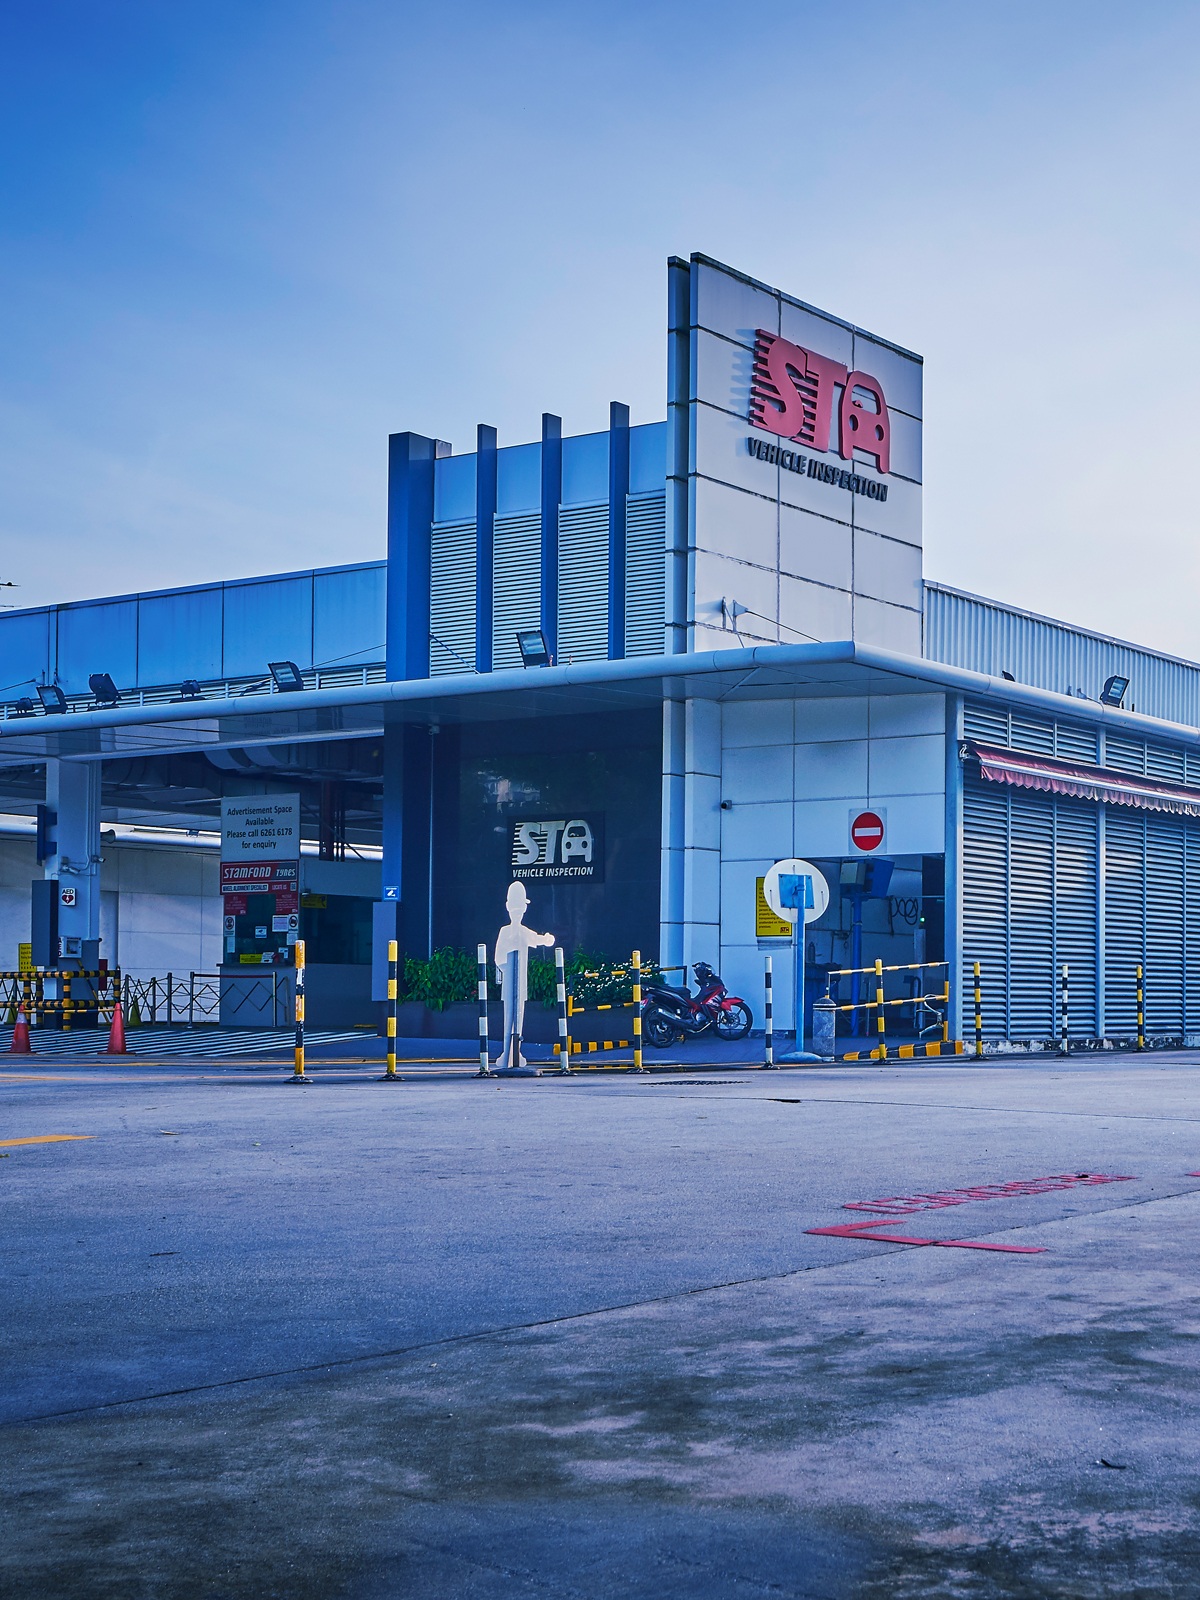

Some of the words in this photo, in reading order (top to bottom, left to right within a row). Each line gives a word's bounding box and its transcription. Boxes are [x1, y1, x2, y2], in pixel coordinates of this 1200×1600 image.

[748, 329, 890, 474] STA
[748, 437, 807, 475] VEHICLE
[807, 459, 888, 502] INSPECTION
[227, 807, 272, 816] Advertisement
[274, 805, 292, 815] Space
[245, 817, 274, 826] Available
[226, 830, 246, 839] Please
[248, 829, 258, 838] call
[260, 829, 275, 837] 6261
[277, 827, 293, 837] 6178
[241, 841, 251, 849] for
[253, 840, 277, 849] enquiry
[512, 820, 592, 866] STA
[512, 868, 544, 878] VEHICLE
[545, 866, 593, 877] INSPECTION
